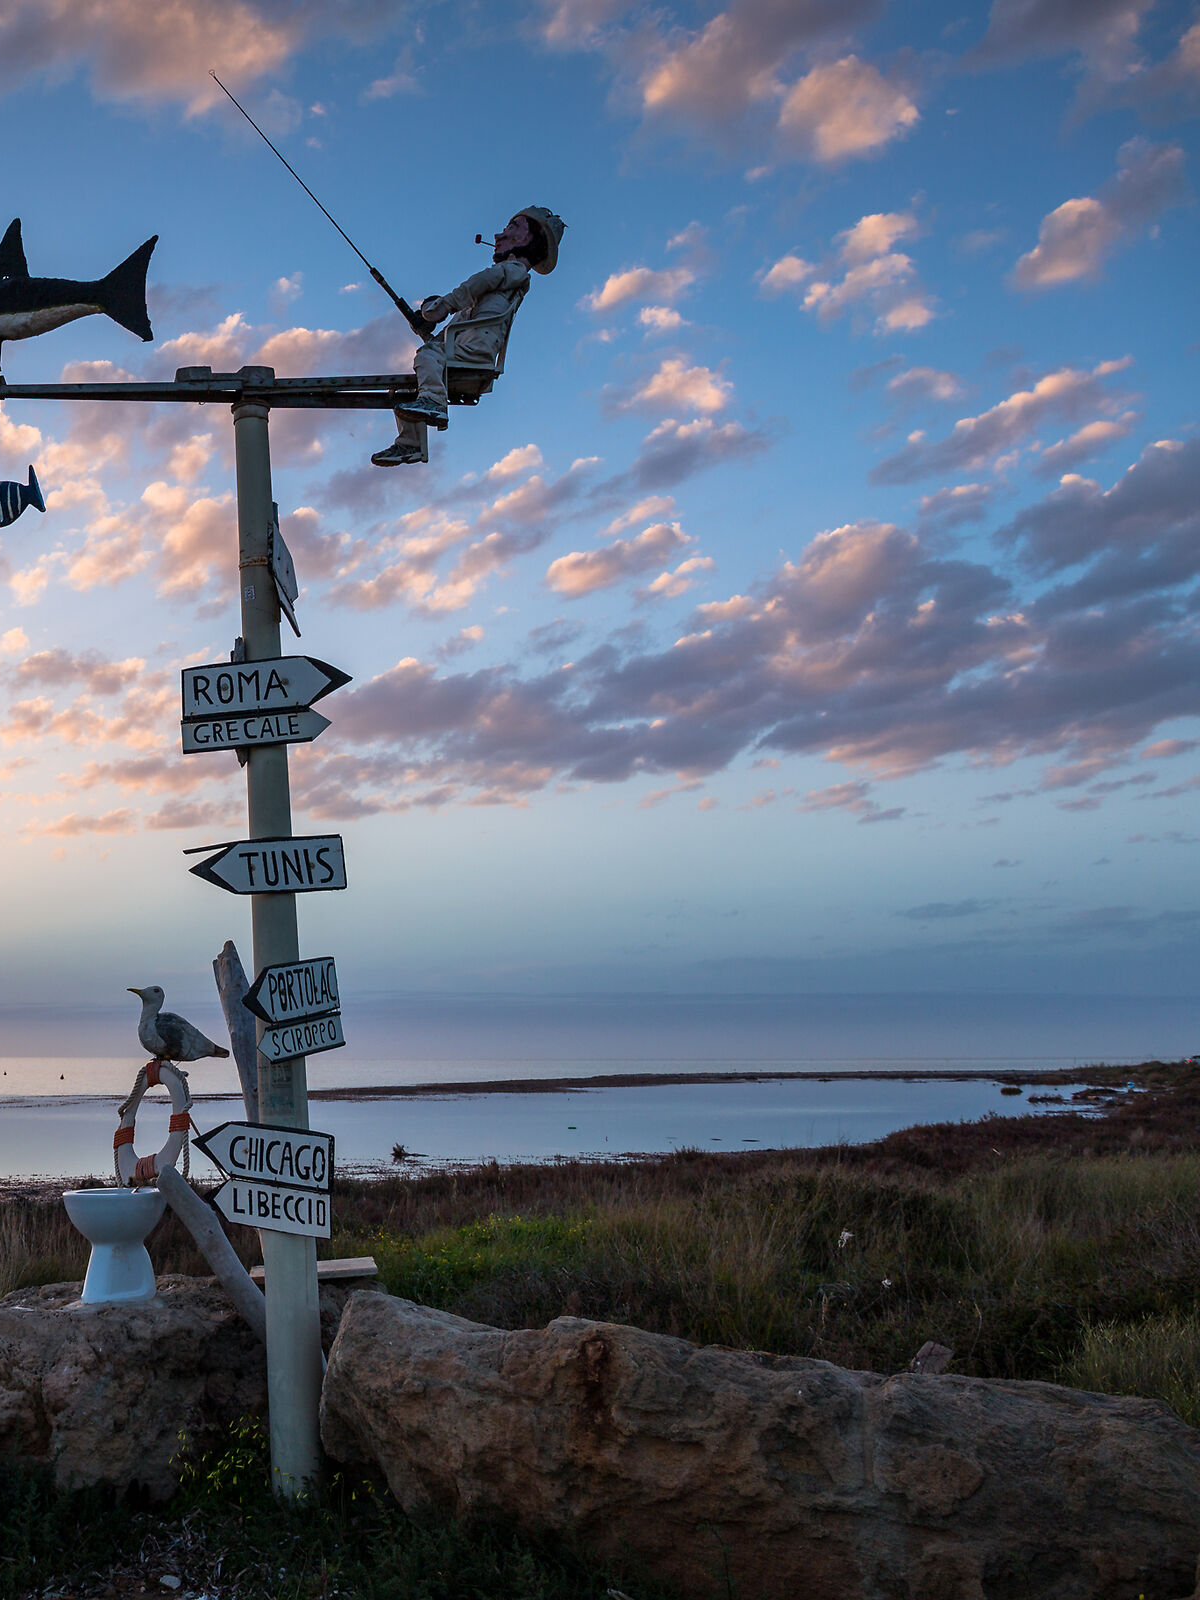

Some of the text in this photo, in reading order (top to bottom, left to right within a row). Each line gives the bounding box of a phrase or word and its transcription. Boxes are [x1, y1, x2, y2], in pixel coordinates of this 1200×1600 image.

[193, 669, 289, 705] ROMA
[193, 715, 300, 744] GRECALE
[238, 847, 335, 887] TUNIS
[272, 1020, 337, 1056] SCIROPPO
[229, 1135, 326, 1182] CHICAGO
[233, 1188, 326, 1227] LIBECCIO
